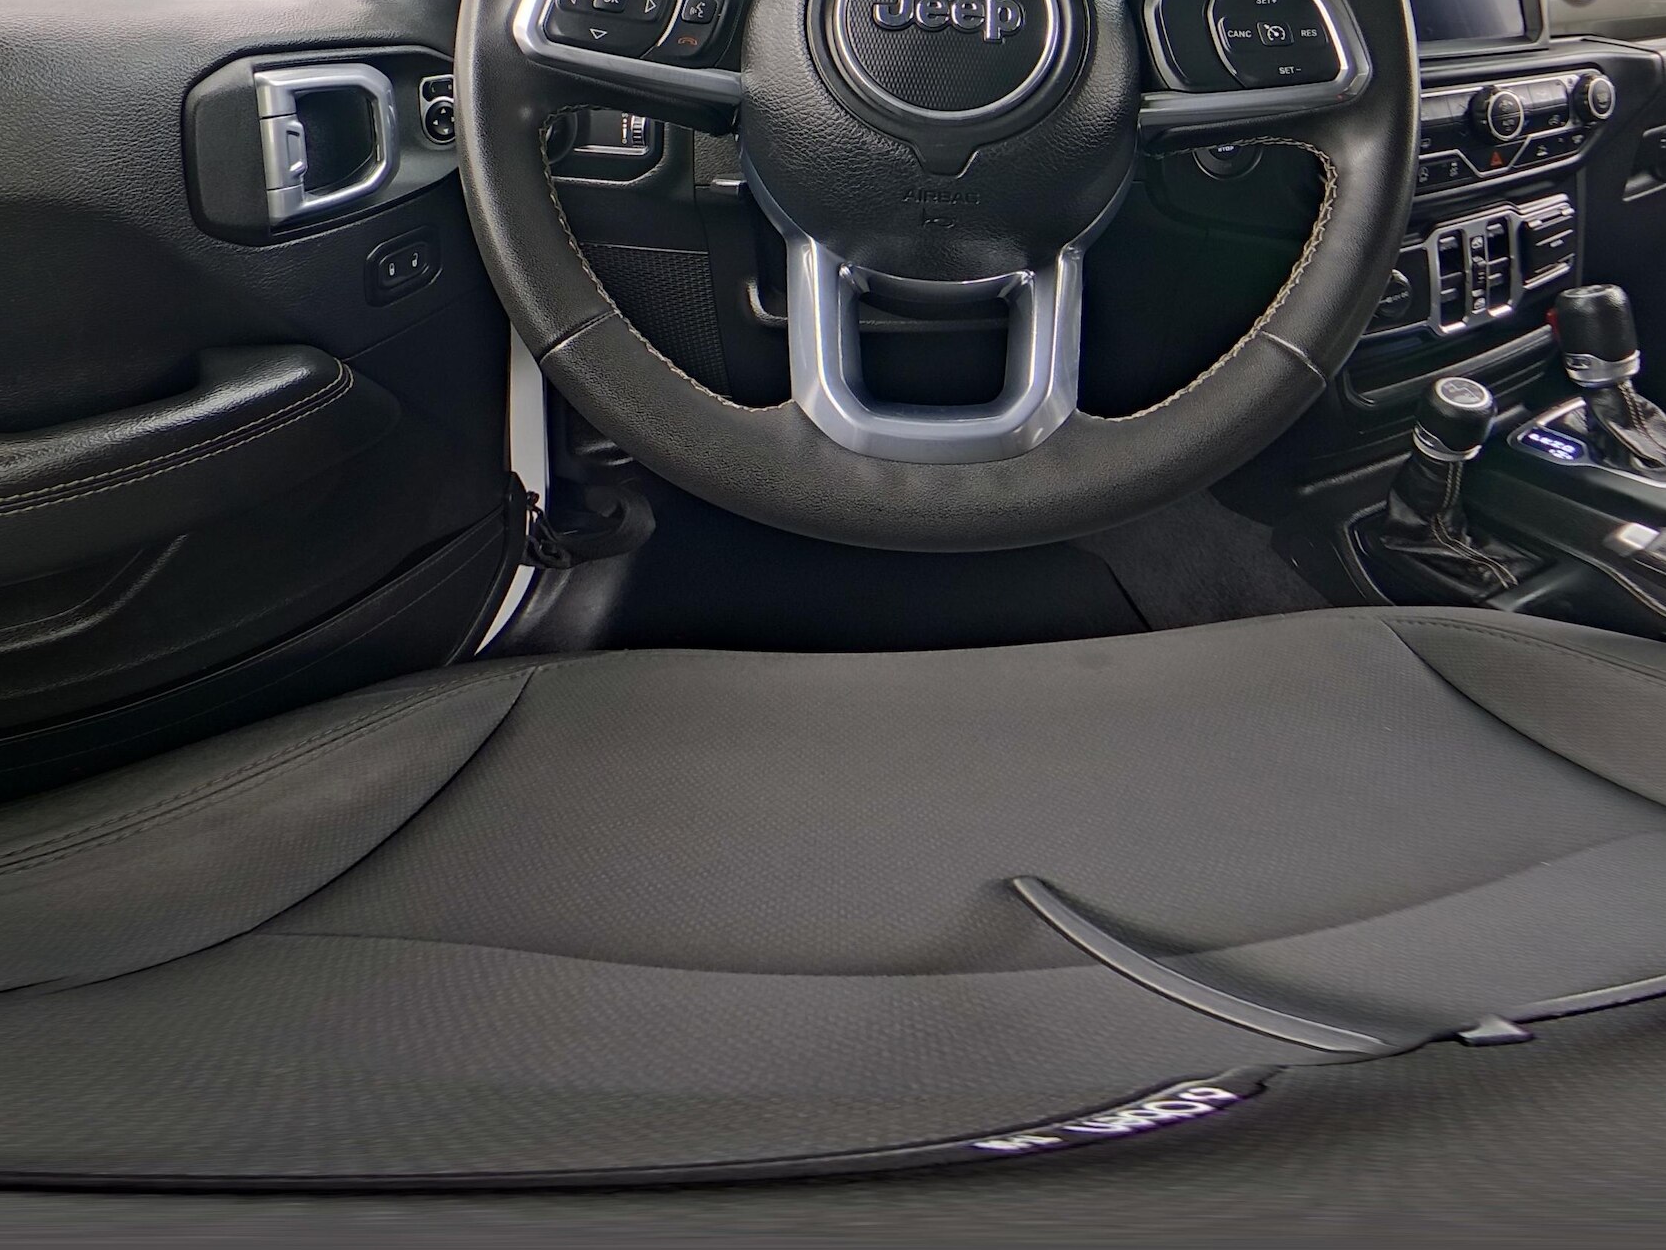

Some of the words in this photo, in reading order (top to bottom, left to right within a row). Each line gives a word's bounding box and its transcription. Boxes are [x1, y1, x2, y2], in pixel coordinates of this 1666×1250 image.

[1227, 30, 1252, 38] CANC
[1300, 29, 1318, 37] RES
[901, 190, 980, 205] AIRBAG
